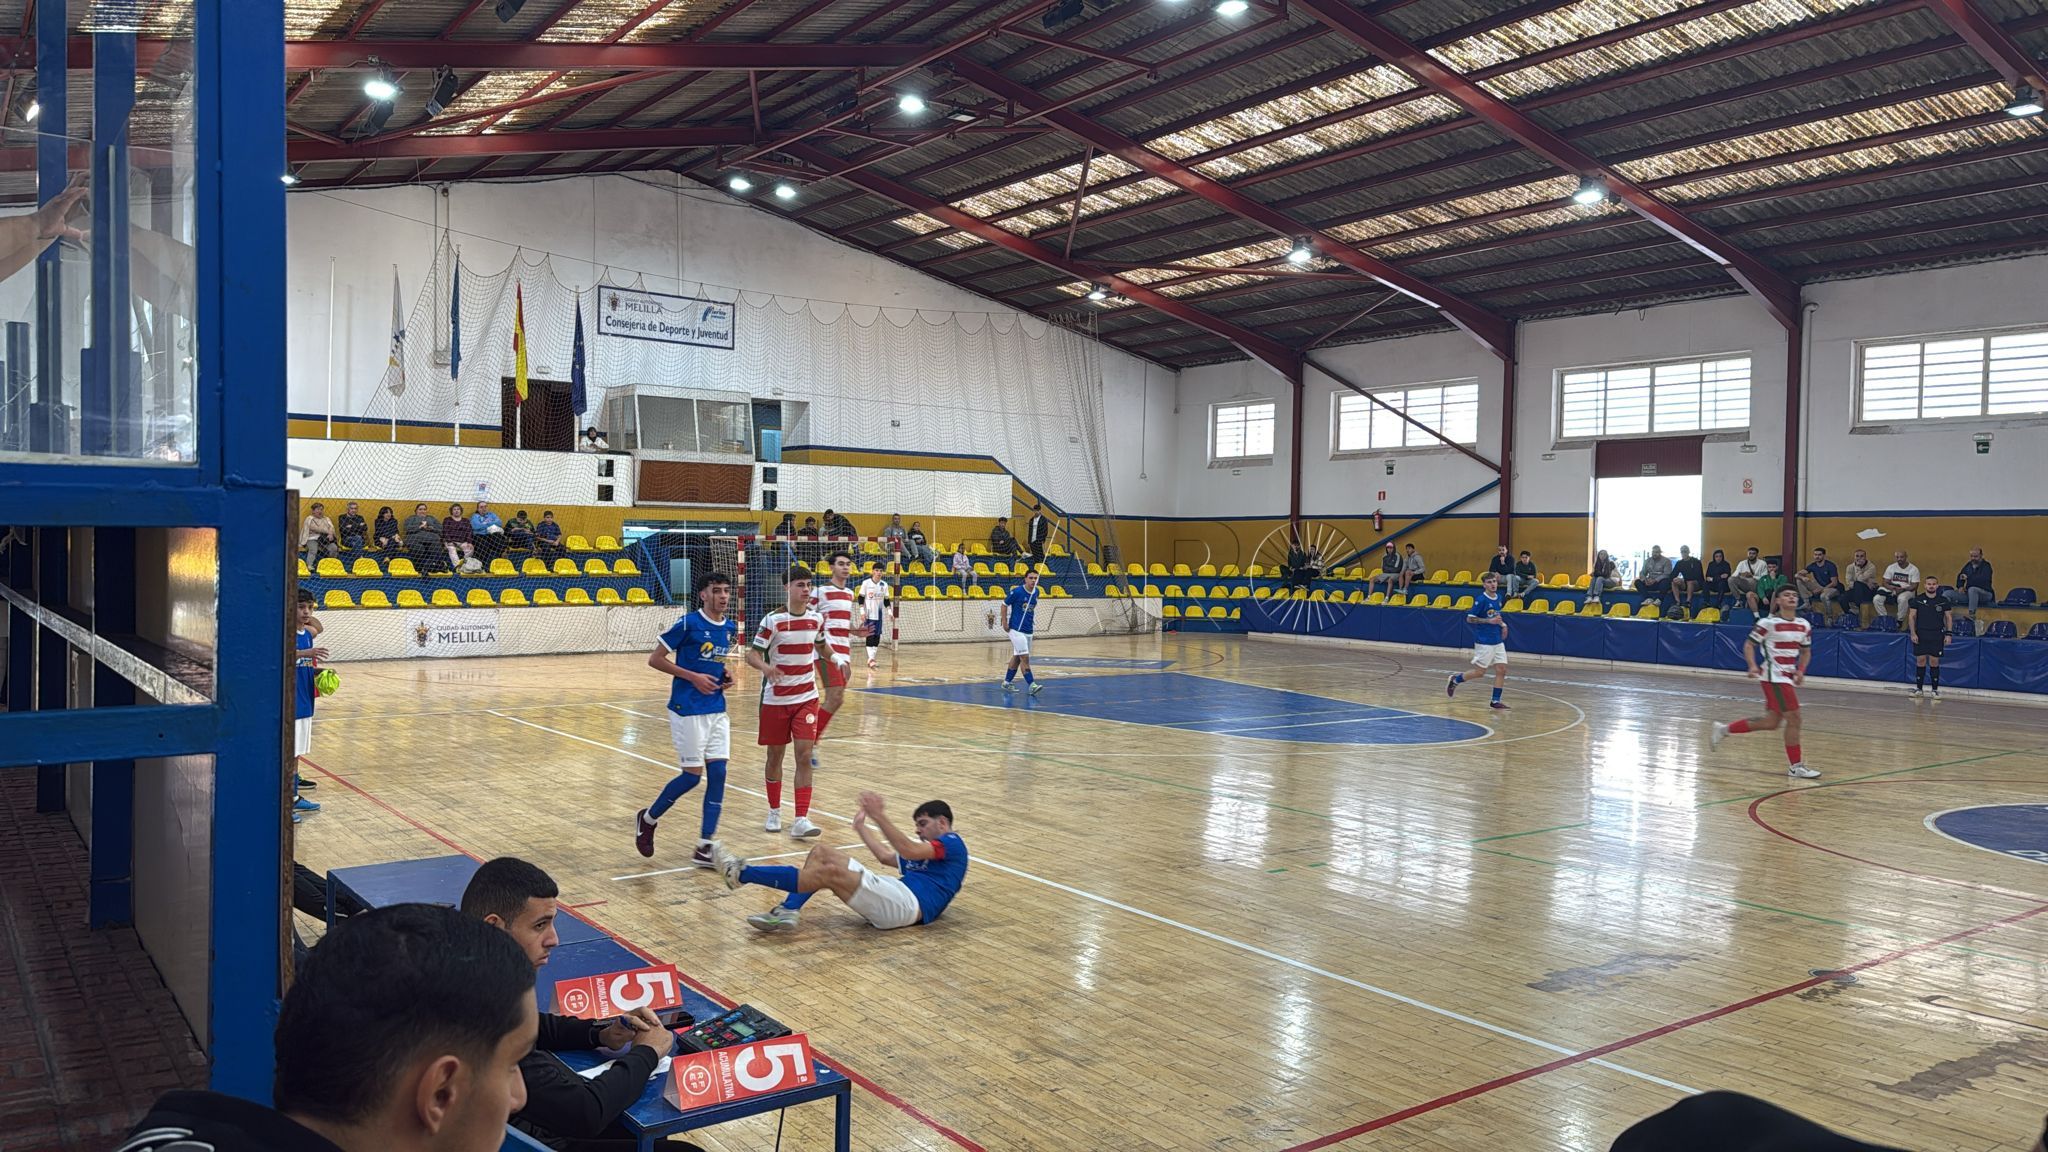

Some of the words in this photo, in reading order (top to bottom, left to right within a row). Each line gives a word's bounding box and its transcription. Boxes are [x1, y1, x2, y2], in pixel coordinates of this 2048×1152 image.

[625, 302, 663, 314] MELILLA
[648, 322, 656, 331] de
[659, 322, 689, 336] Deporte
[691, 329, 697, 339] y
[697, 328, 728, 340] Juventud
[438, 632, 495, 643] MELILLA
[717, 1051, 736, 1100] ACUMULATIVA
